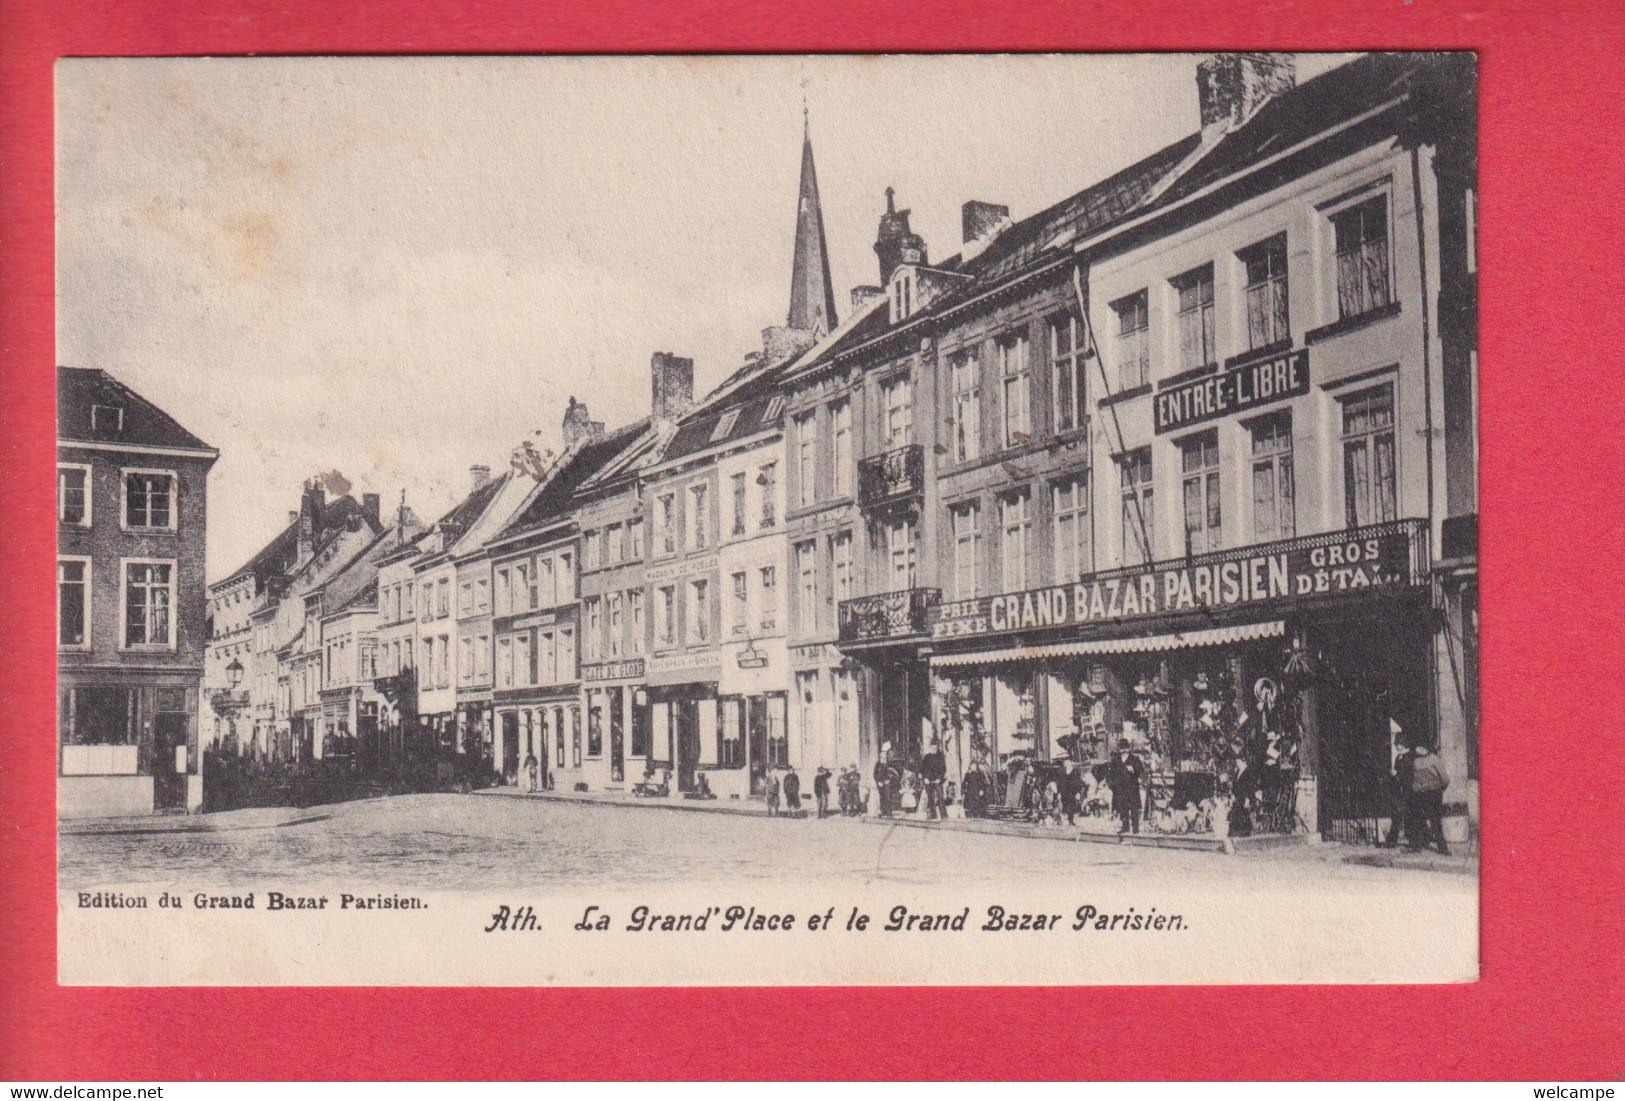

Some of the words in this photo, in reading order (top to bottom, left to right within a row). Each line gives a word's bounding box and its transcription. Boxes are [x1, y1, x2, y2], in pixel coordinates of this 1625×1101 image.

[1311, 540, 1379, 567] GROS
[991, 588, 1067, 631] GRAND
[1074, 573, 1156, 622] BAZAR
[1164, 553, 1289, 611] PARISIEN
[940, 600, 980, 620] PRIX
[932, 617, 987, 638] FIXE
